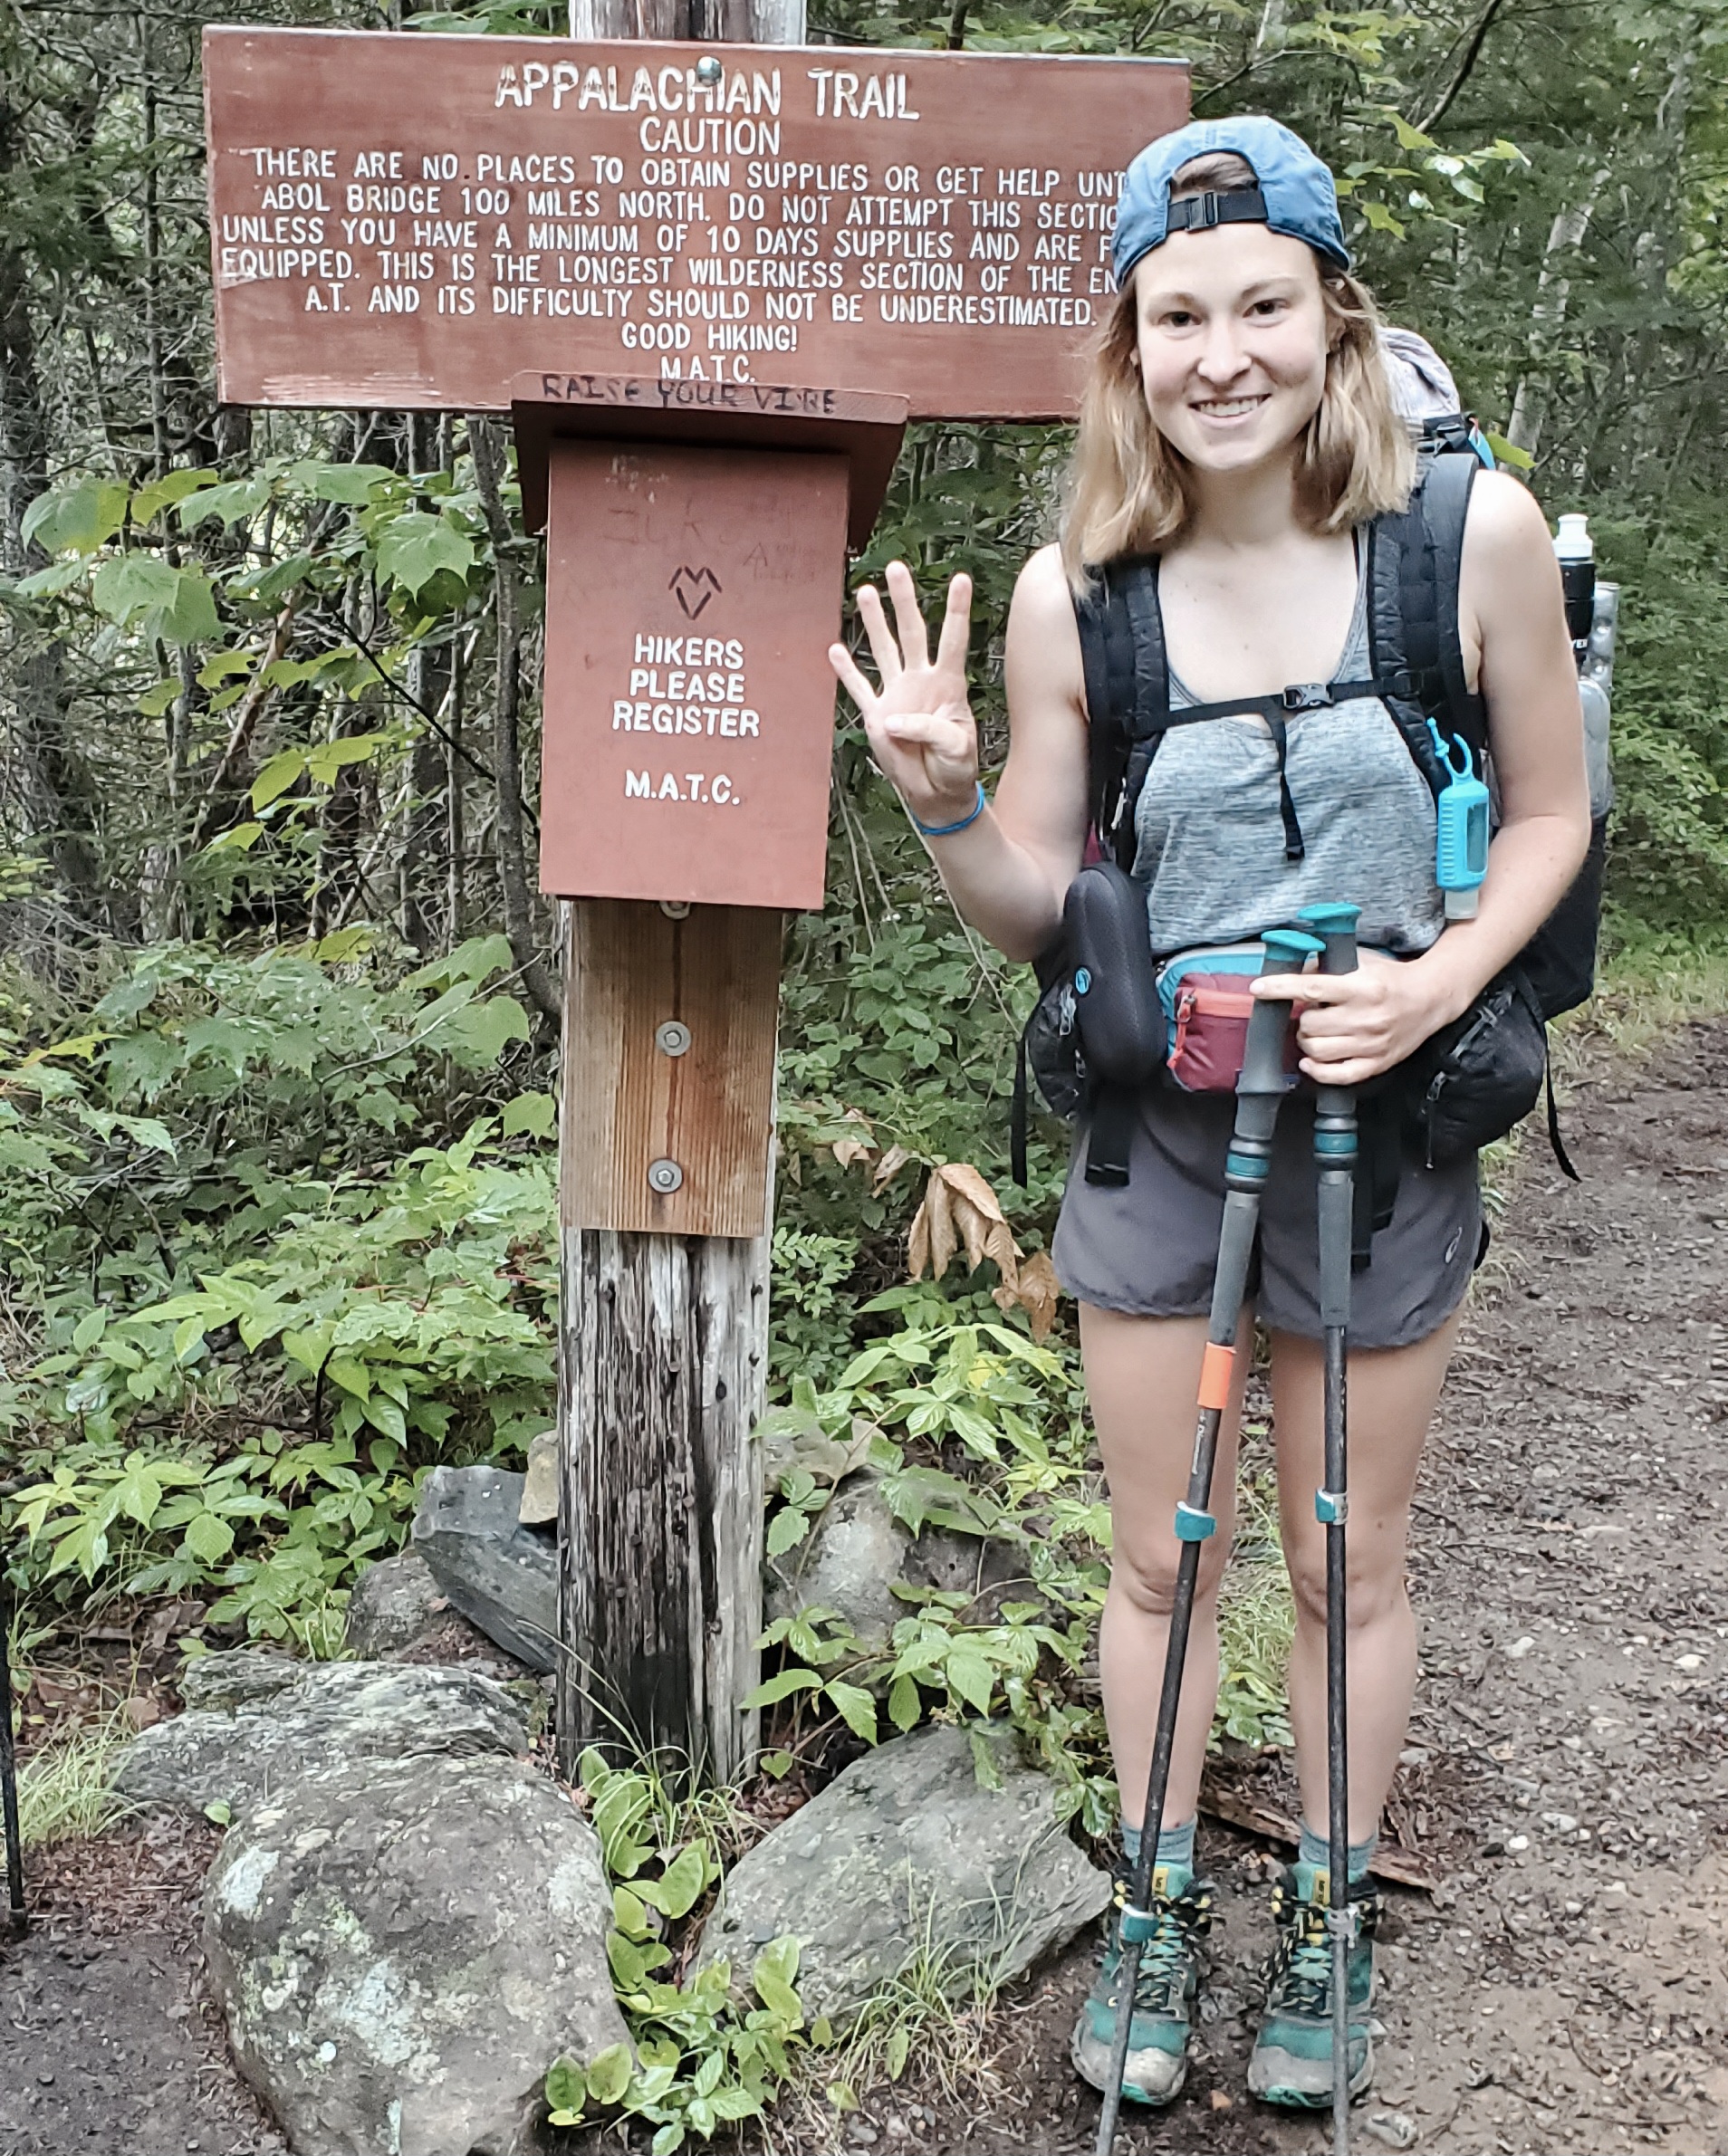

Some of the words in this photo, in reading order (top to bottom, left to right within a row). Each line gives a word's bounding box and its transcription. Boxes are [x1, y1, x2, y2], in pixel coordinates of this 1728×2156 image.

[494, 60, 782, 116] APPALACHIAN
[807, 67, 920, 120] TRAIL
[639, 116, 781, 156] CAUTION
[254, 148, 337, 178] THERE
[353, 150, 404, 179] ARE
[422, 153, 458, 181] NO
[476, 153, 575, 184] PLACES
[590, 155, 624, 185] TO
[640, 158, 730, 187] OBTAIN
[746, 160, 869, 192] SUPPLIES
[884, 165, 920, 194] OR
[936, 166, 984, 196] GET
[998, 168, 1061, 197] HELP
[1078, 171, 1126, 198] UNT
[261, 182, 331, 212] ABOL
[346, 183, 441, 214] BRIDGE
[460, 187, 510, 216] 100
[527, 187, 600, 217] MILES
[619, 190, 711, 222] NORTH.
[729, 192, 765, 221] DO
[782, 194, 832, 225] NOT
[845, 195, 955, 227] ATTEMPT
[967, 198, 1021, 228] THIS
[1037, 202, 1118, 231] SECTIO
[223, 216, 323, 244] UNLESS
[340, 216, 396, 246] YOU
[413, 219, 478, 249] HAVE
[494, 222, 513, 250] A
[528, 222, 638, 253] MINIMUM
[657, 223, 689, 253] OF
[706, 225, 741, 254] 10
[755, 226, 819, 257] DAYS
[832, 228, 955, 259] SUPPLIES
[968, 230, 1020, 262] AND
[1033, 233, 1082, 262] ARE
[222, 249, 360, 279] EQUIPPED.
[376, 250, 435, 281] THIS
[451, 252, 475, 282] IS
[490, 253, 541, 283] THE
[558, 254, 674, 285] LONGEST
[687, 257, 844, 289] WILDERNESS
[859, 260, 964, 292] SECTION
[980, 264, 1012, 292] OF
[1026, 264, 1072, 293] THE
[304, 282, 351, 312] A.T.
[367, 284, 420, 313] AND
[437, 284, 475, 315] ITS
[492, 285, 633, 318] DIFFICULTY
[647, 288, 750, 321] SHOULD
[765, 292, 817, 321] NOT
[831, 292, 864, 322] BE
[880, 293, 1098, 327] UNDERESTIMATED.
[621, 321, 691, 350] GOOD
[707, 323, 797, 352] HIKING!
[660, 354, 755, 383] M.A.T.C.
[658, 378, 738, 407] YOUR
[634, 633, 744, 670] HIKERS
[629, 668, 745, 704] PLEASE
[612, 700, 760, 737] REGISTER
[625, 769, 740, 805] M.A.T.C.
